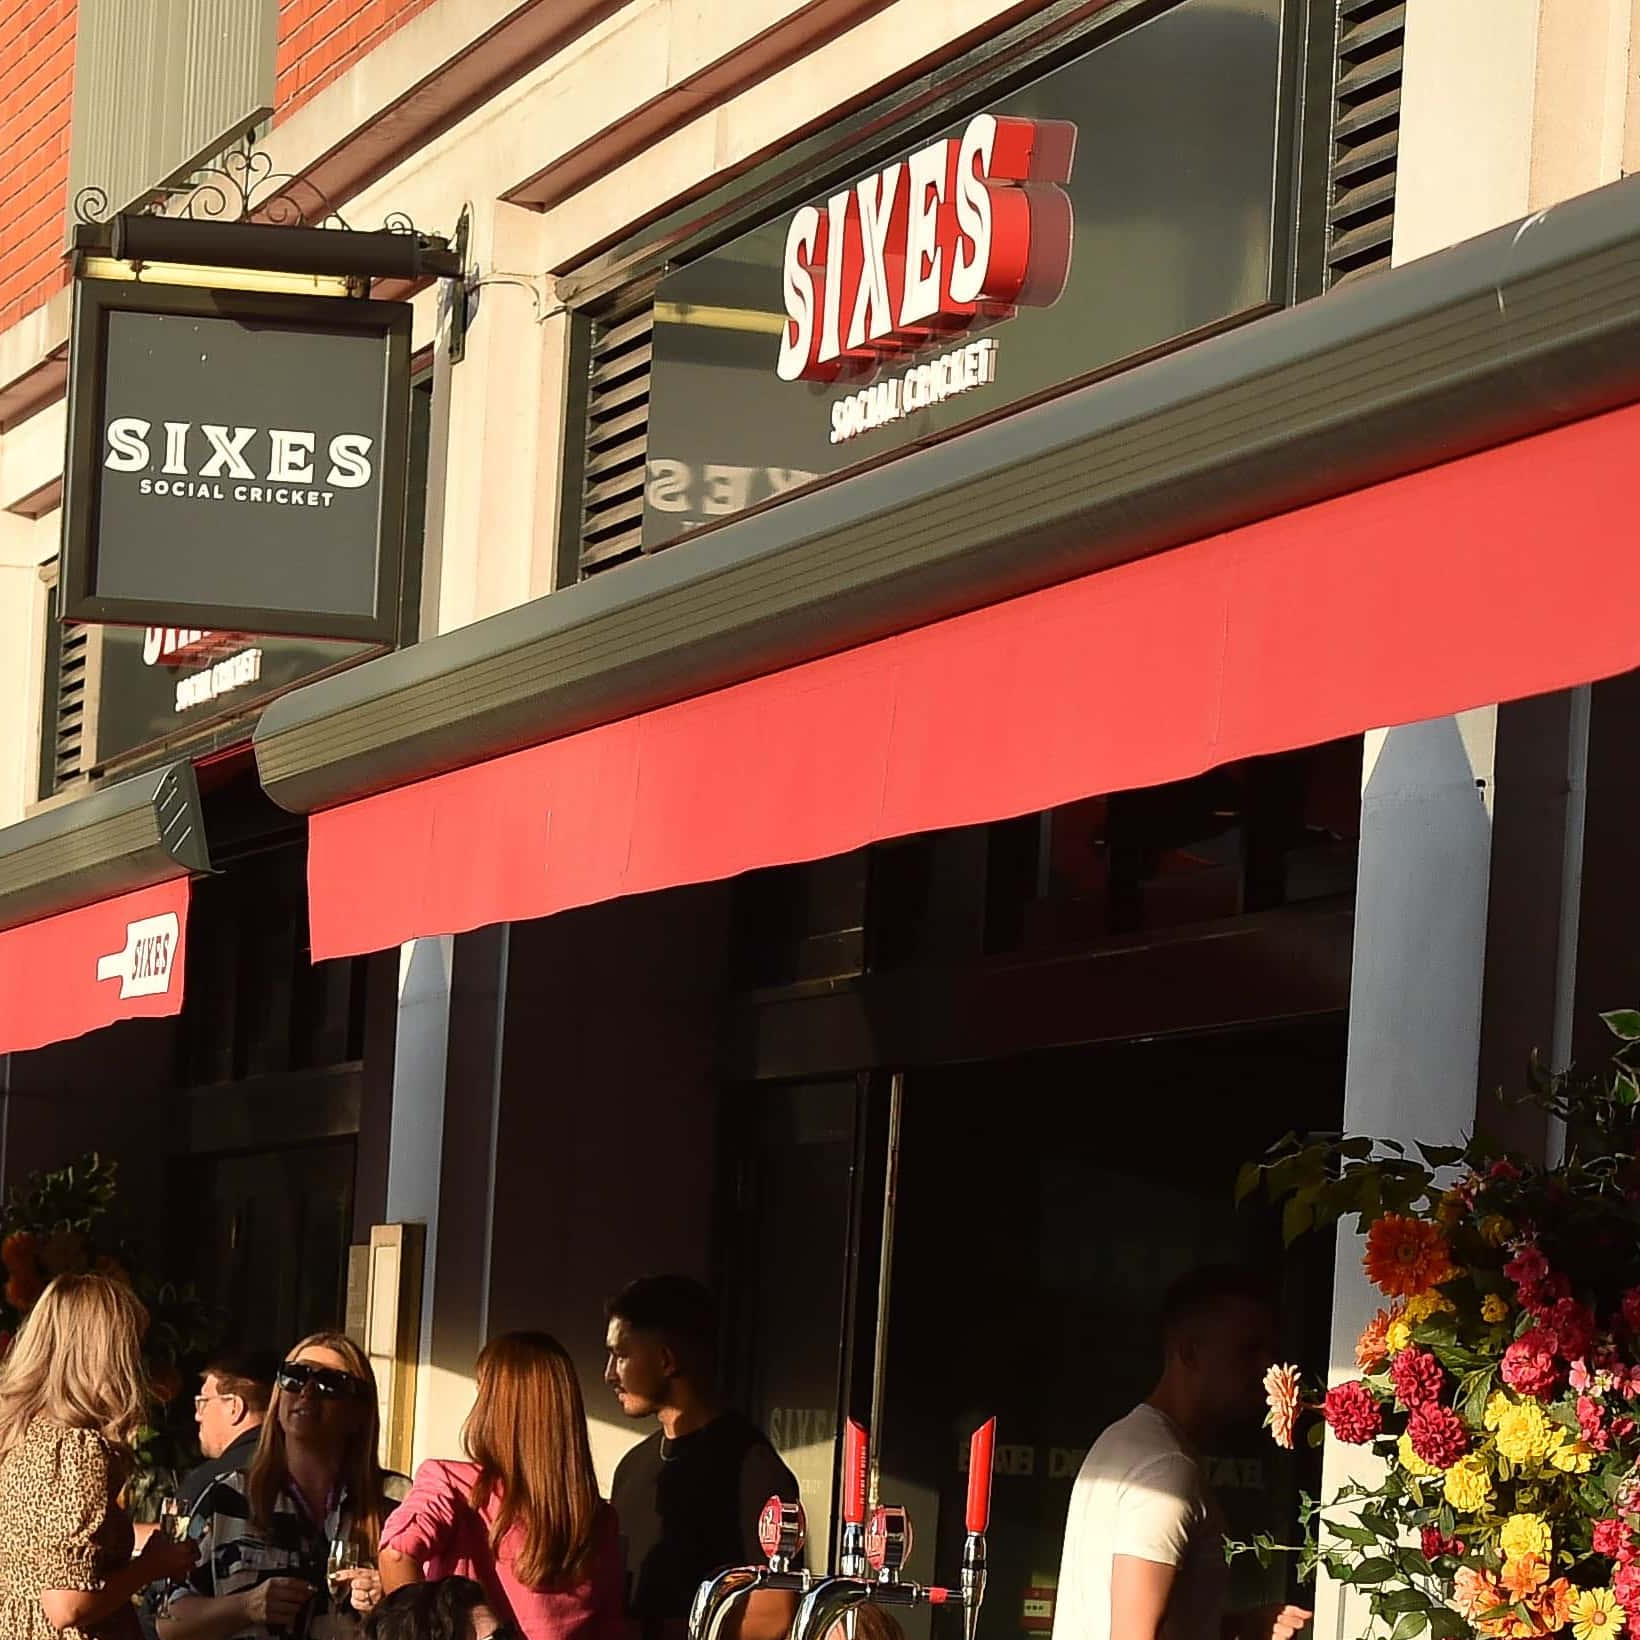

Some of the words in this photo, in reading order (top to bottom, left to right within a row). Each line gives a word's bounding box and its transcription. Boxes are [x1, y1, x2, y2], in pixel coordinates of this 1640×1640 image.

[777, 113, 1000, 382] SIXES
[829, 378, 903, 444] SOCIAL
[903, 338, 998, 413] CRICKET
[103, 416, 374, 489] SIXES
[138, 478, 225, 501] SOCIAL
[233, 484, 335, 508] CRICKET
[131, 932, 170, 981] SIXES
